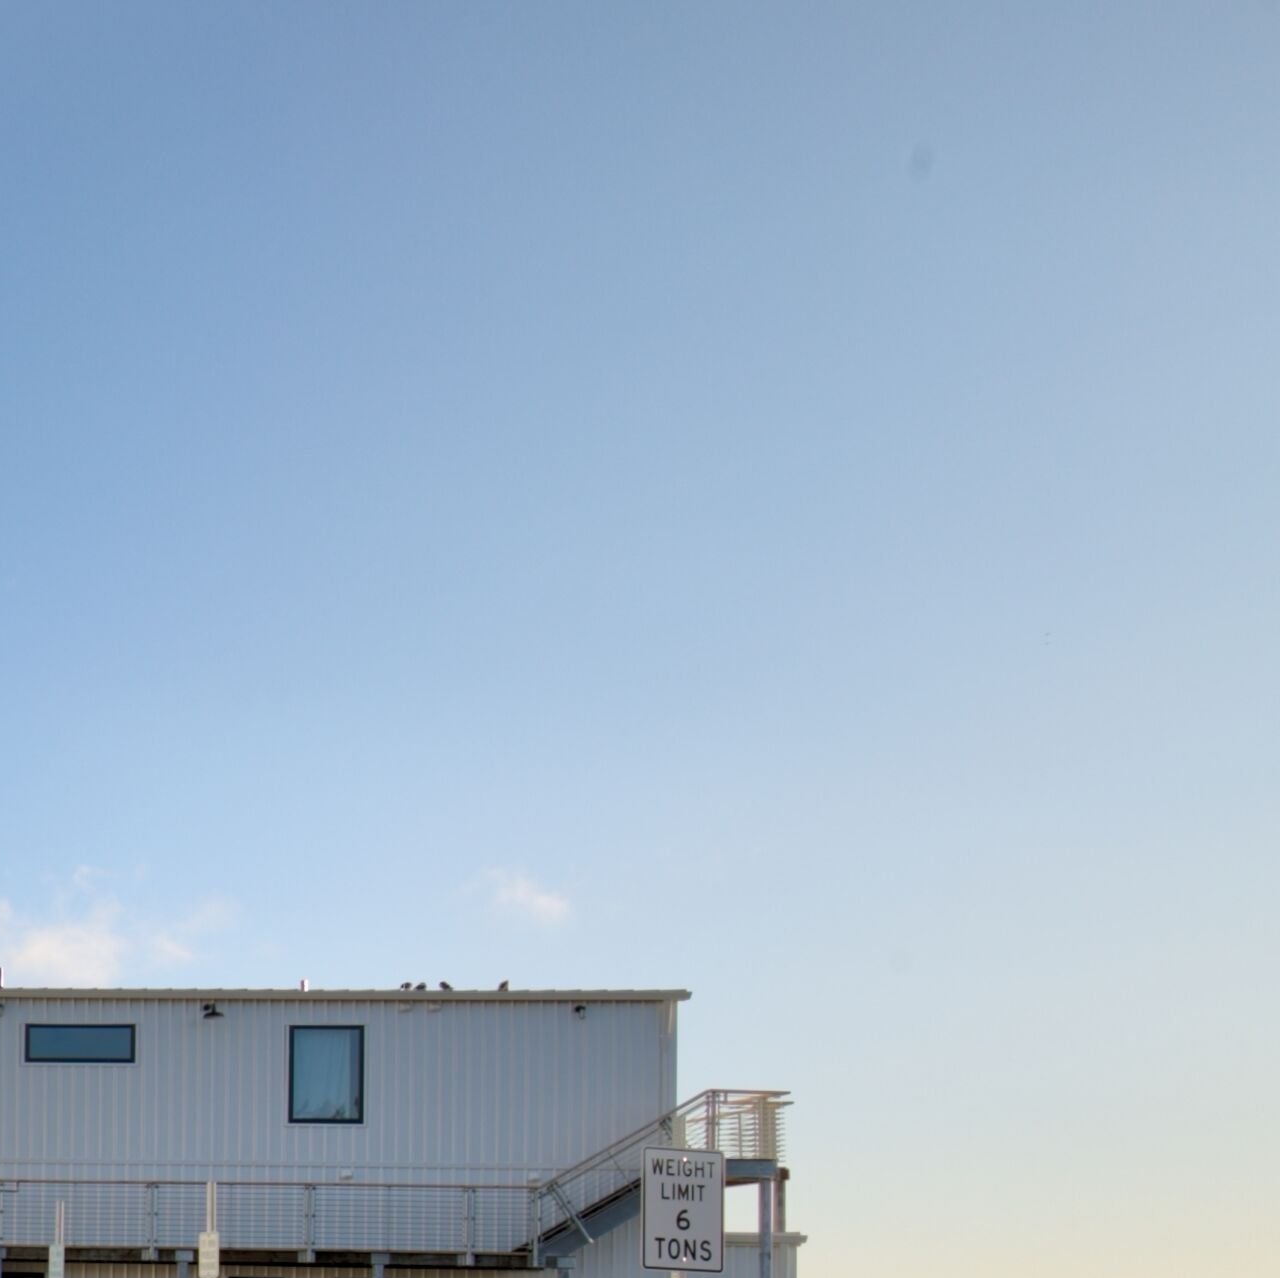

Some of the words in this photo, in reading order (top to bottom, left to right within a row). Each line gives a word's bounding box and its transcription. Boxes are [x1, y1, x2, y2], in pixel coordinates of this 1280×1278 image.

[651, 1158, 715, 1179] WEIGHT
[660, 1182, 706, 1202] LIMIT
[675, 1208, 691, 1231] 6
[654, 1237, 713, 1262] TONS
